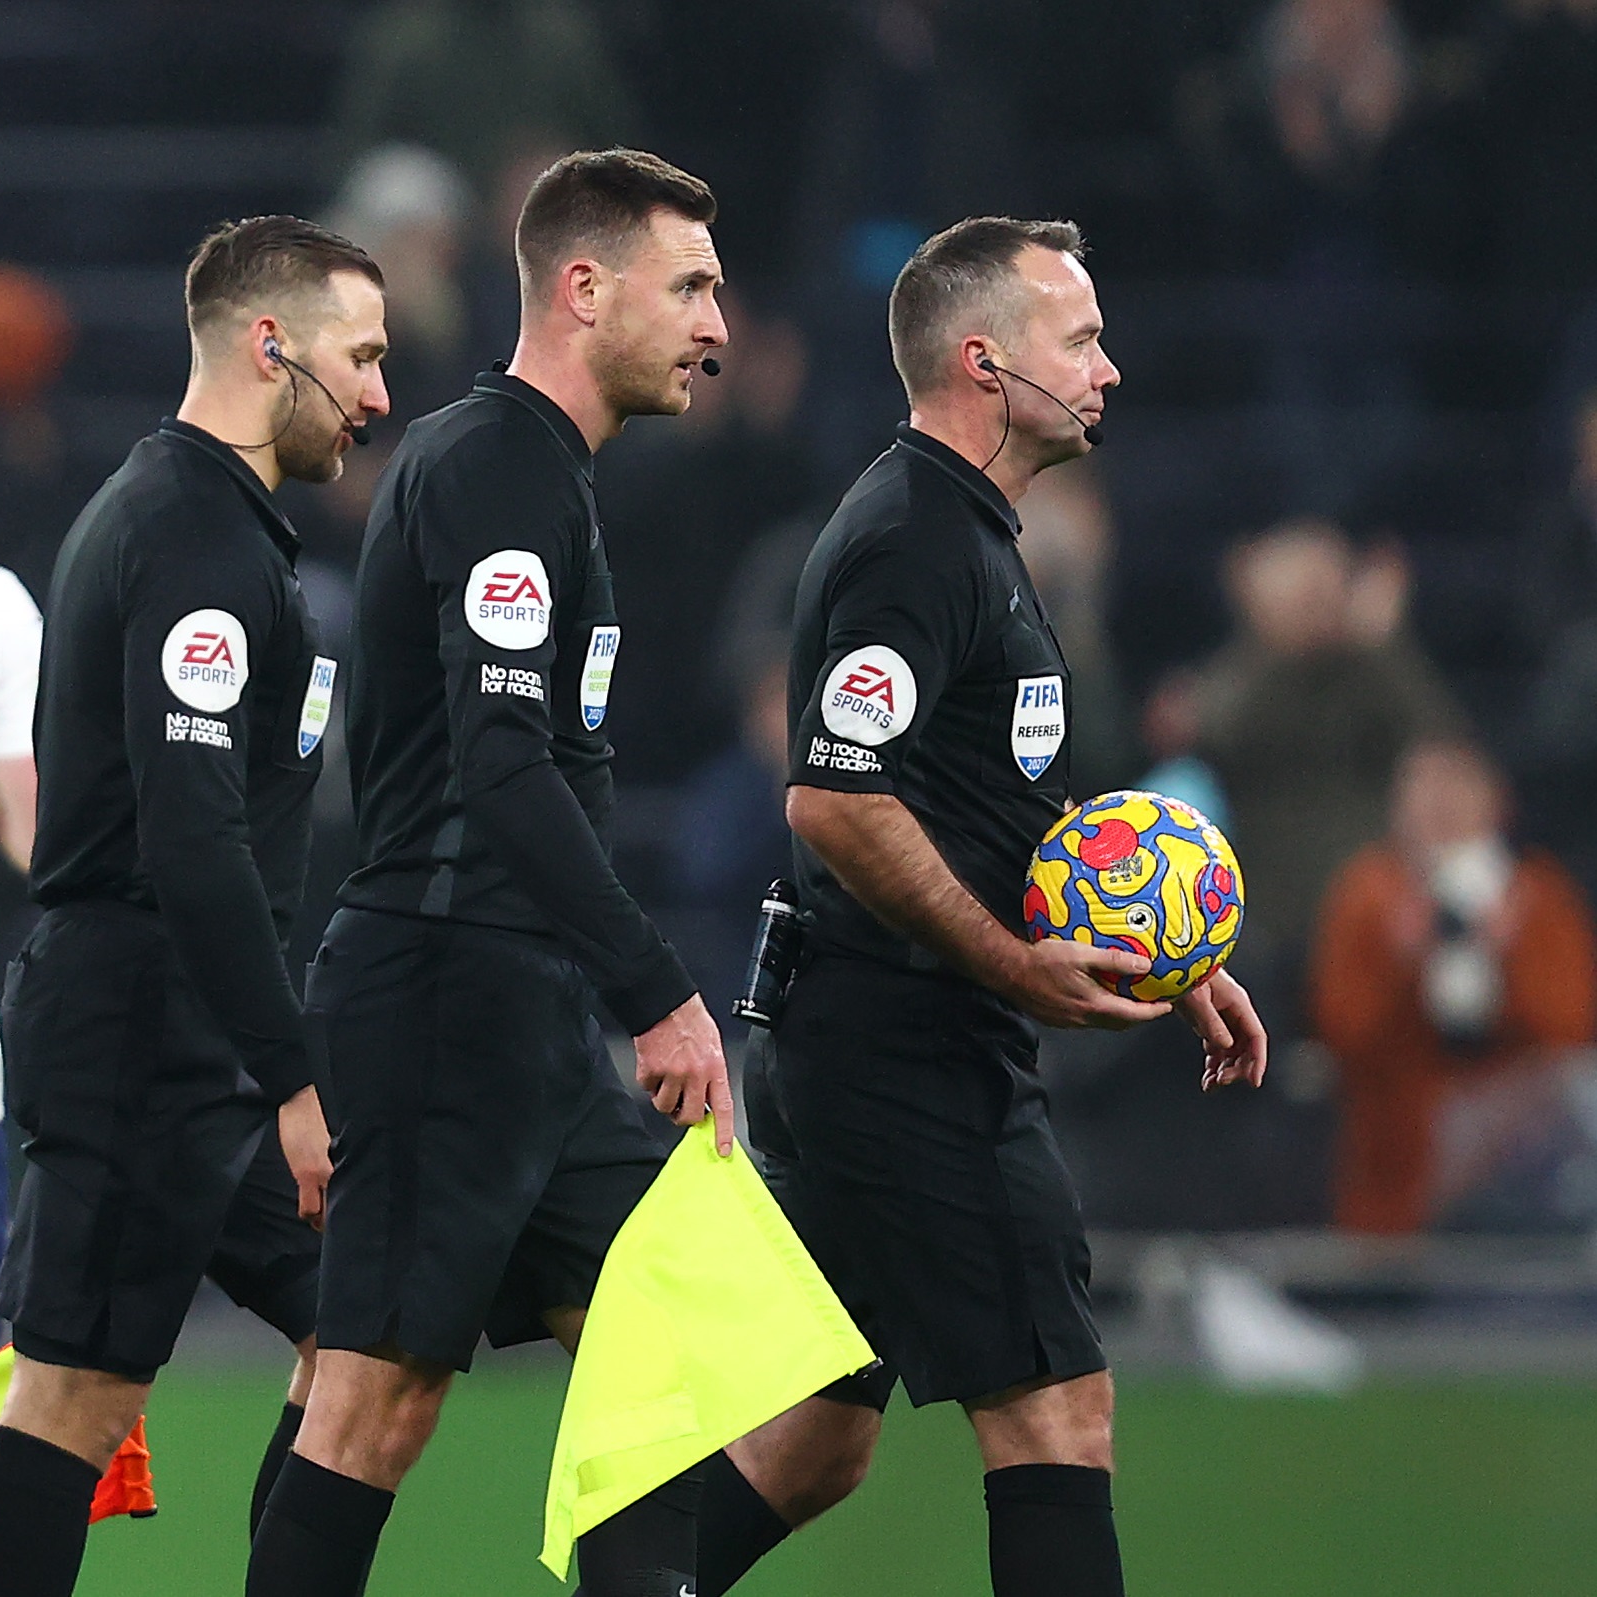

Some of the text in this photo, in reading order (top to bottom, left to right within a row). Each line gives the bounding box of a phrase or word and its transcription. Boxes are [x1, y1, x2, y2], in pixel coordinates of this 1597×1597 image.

[482, 572, 544, 607] EA
[479, 604, 546, 624] SPORTS
[181, 632, 235, 669] EA
[593, 634, 617, 656] FIFA
[178, 666, 236, 685] SPORTS
[482, 664, 541, 686] No room
[839, 664, 894, 714] EA
[1021, 683, 1059, 708] FIFA
[832, 692, 893, 728] SPORTS
[166, 712, 228, 735] No room
[1017, 724, 1061, 738] REFEREE
[190, 729, 232, 749] racism
[810, 736, 877, 762] No room
[830, 756, 882, 772] racism
[1026, 758, 1046, 770] 2021
